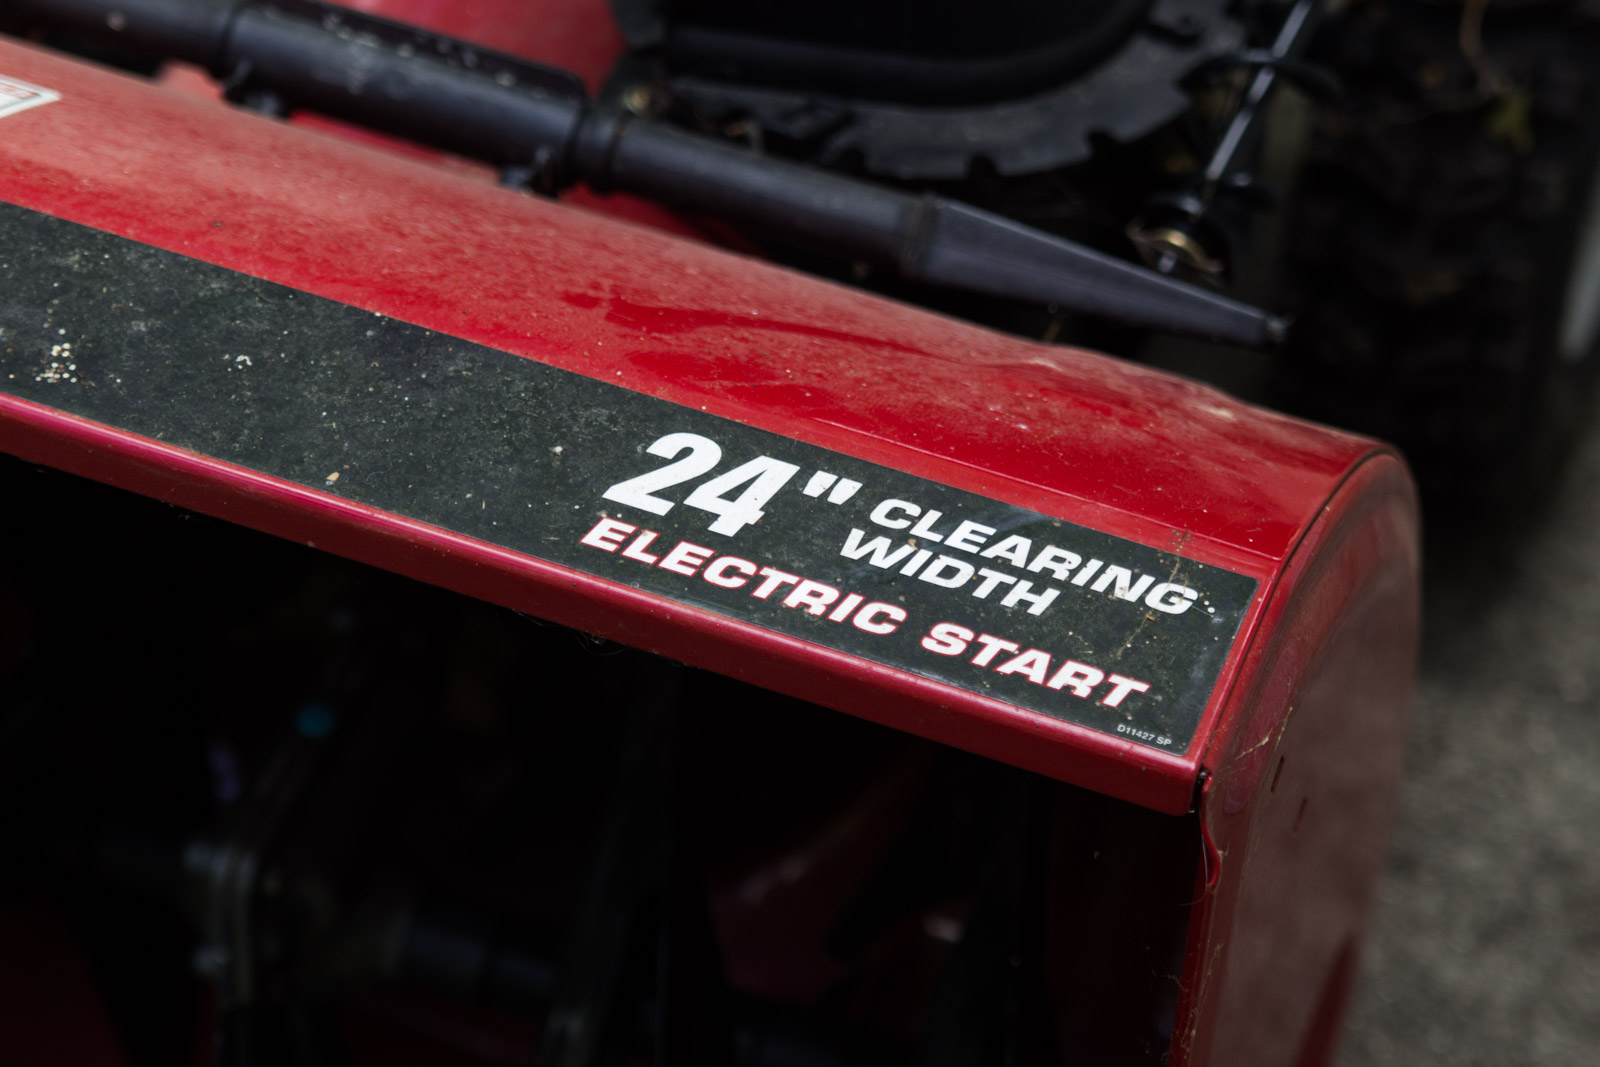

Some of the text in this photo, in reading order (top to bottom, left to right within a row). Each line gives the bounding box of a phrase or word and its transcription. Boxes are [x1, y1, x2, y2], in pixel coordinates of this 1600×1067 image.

[602, 432, 863, 537] 24"
[840, 528, 1061, 616] WIDTH
[869, 498, 1198, 615] CLEARING
[579, 516, 1150, 708] ELECTRIC START
[1117, 724, 1172, 745] D11427 SP
